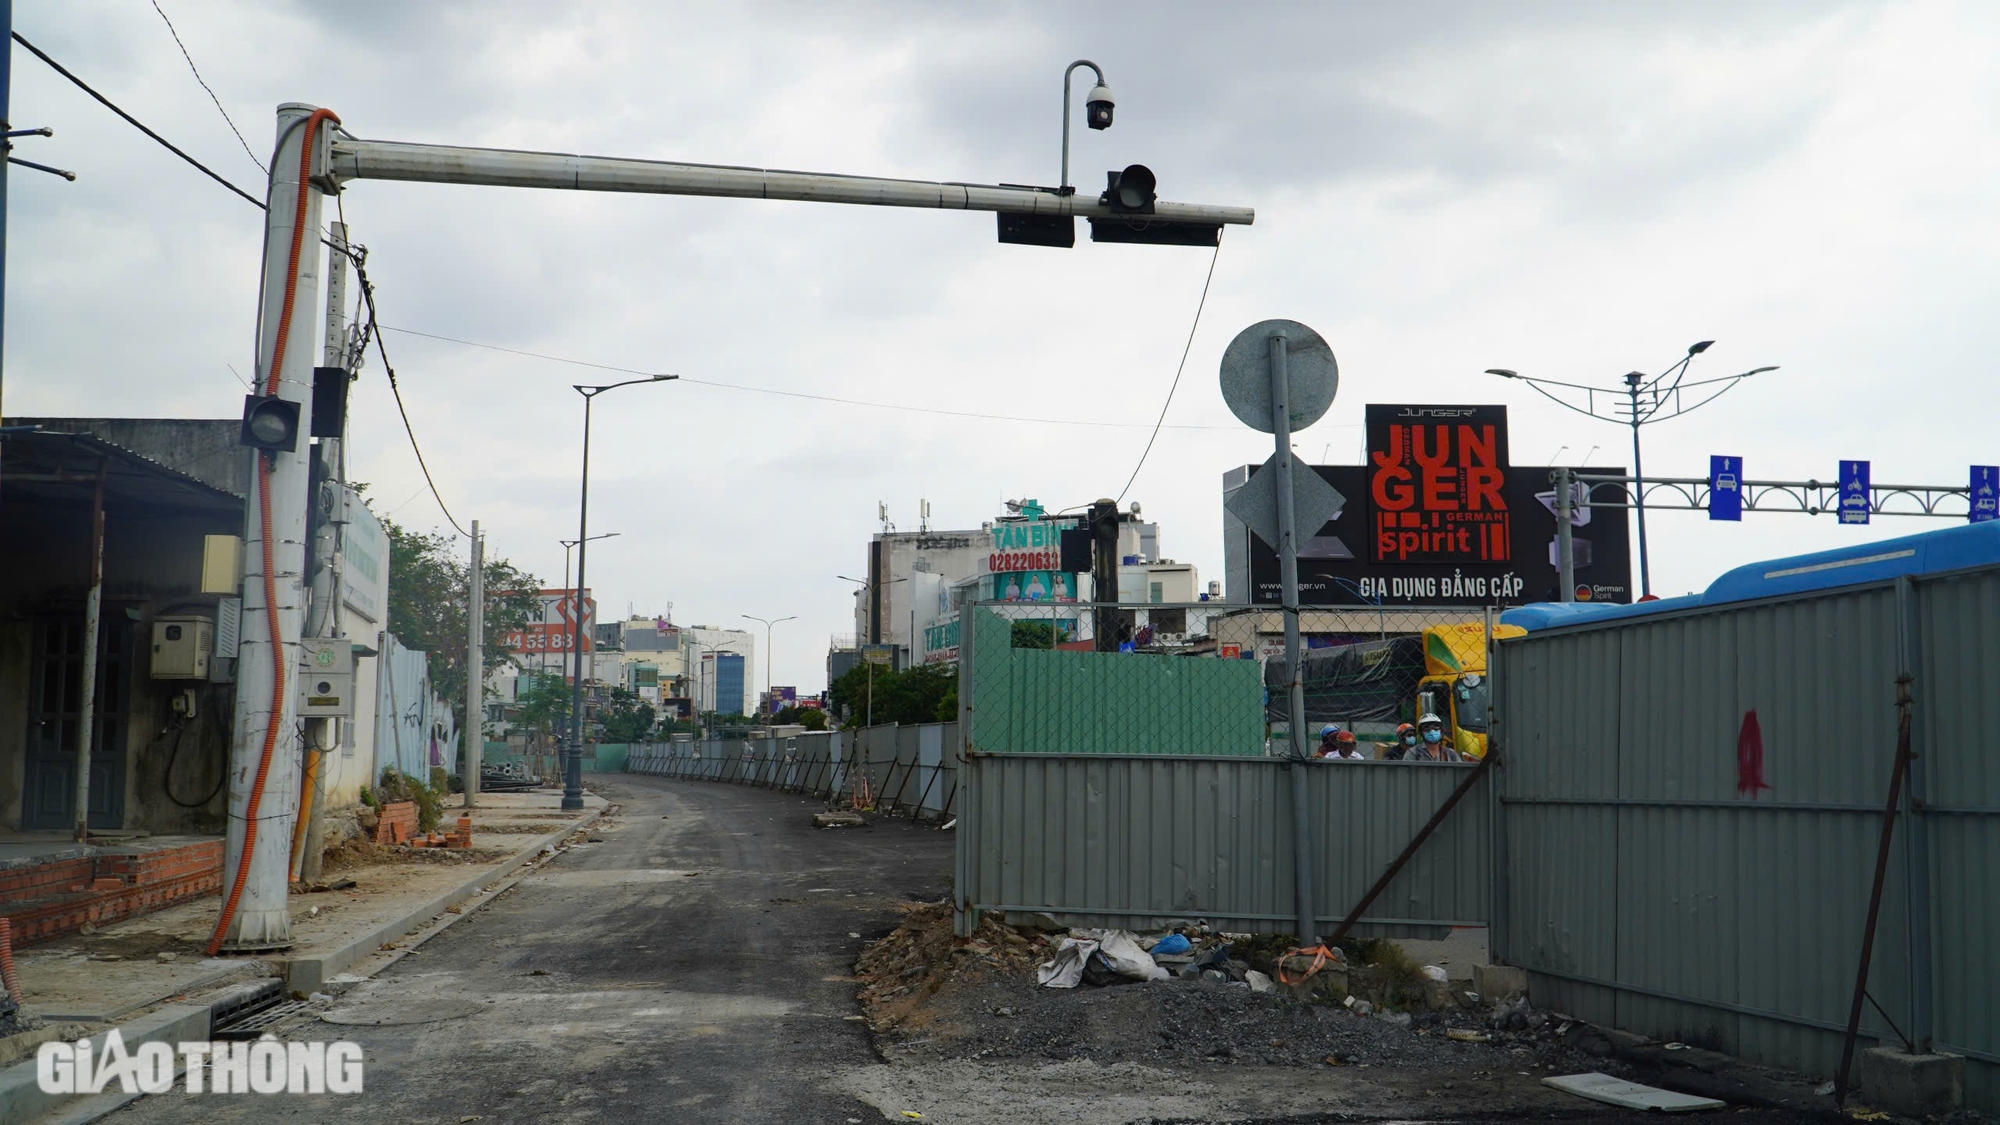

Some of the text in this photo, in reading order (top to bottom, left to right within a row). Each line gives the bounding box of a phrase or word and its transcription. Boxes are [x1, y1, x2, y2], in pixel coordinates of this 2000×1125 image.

[1372, 424, 1497, 468] JUN
[1372, 466, 1509, 511] GER
[1446, 512, 1503, 522] GERMAN
[992, 523, 1028, 549] TÂN
[989, 551, 1061, 572] 028220633
[1360, 577, 1388, 597] GIA
[1392, 577, 1436, 601] DỤNG
[1490, 571, 1524, 597] CẤP
[1593, 584, 1624, 593] German
[1458, 625, 1501, 633] ISUU
